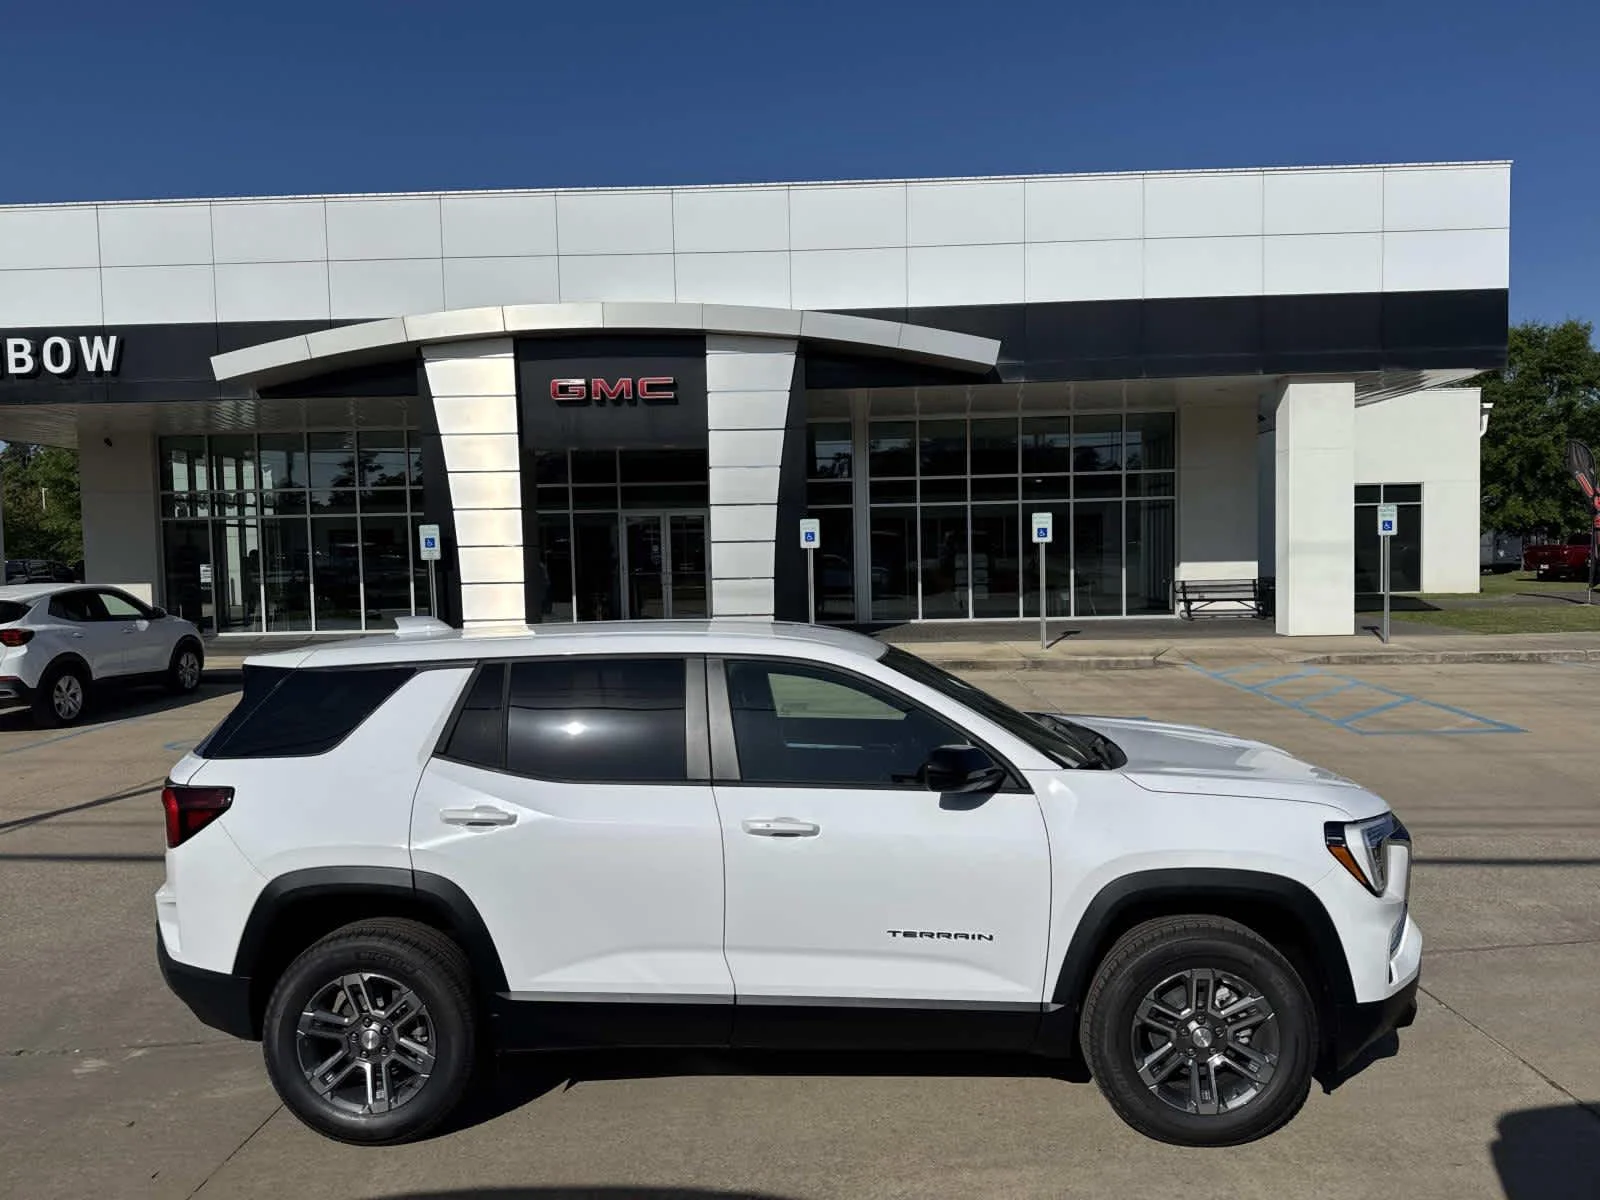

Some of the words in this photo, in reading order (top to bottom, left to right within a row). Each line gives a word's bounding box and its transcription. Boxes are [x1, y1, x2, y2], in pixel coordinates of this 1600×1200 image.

[6, 336, 117, 374] BOW
[550, 376, 675, 401] GMC
[886, 930, 994, 942] TERRAIN
